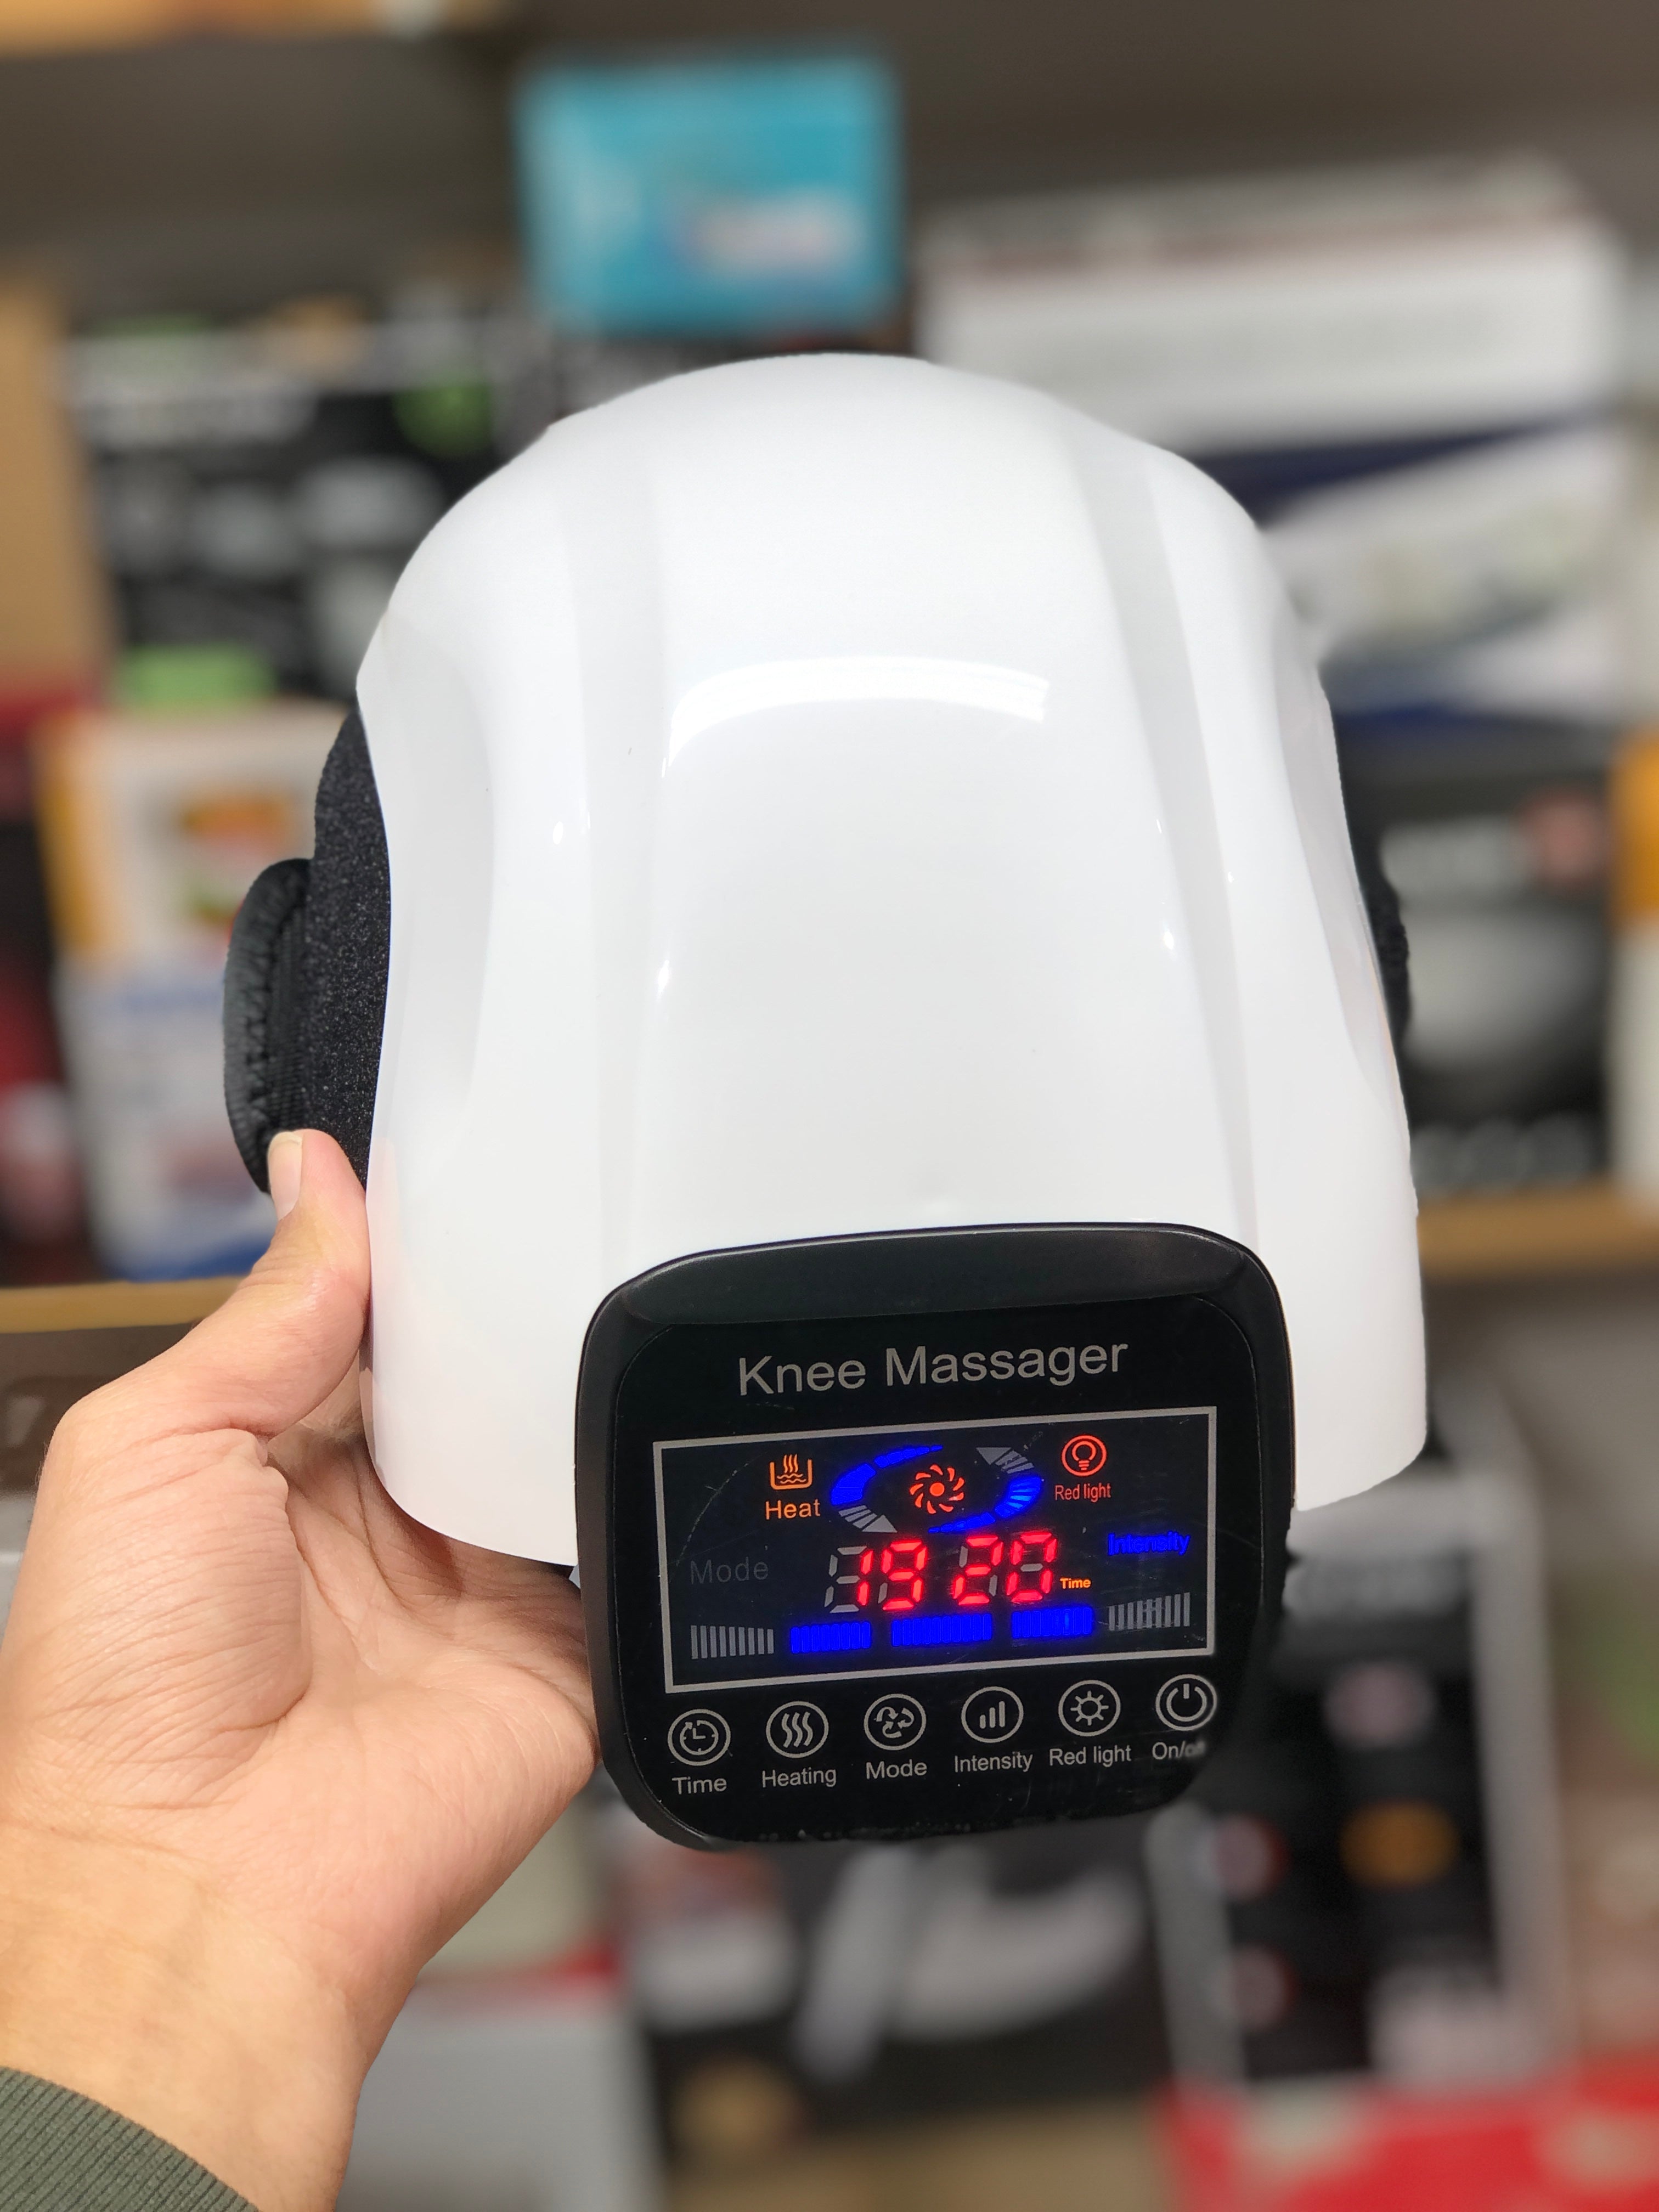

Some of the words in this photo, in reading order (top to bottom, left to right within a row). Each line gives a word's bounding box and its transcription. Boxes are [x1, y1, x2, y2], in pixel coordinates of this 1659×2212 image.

[740, 1356, 865, 1395] Knee
[887, 1344, 1127, 1386] Massager
[1056, 1485, 1080, 1499] Red
[1084, 1483, 1110, 1502] light
[766, 1499, 820, 1519] Heat
[1109, 1532, 1189, 1554] Intensity
[691, 1557, 768, 1584] Mode
[1060, 1578, 1091, 1589] Time
[955, 1752, 1032, 1772] Intensity
[1050, 1747, 1086, 1765] Red
[1094, 1745, 1131, 1767] light
[763, 1767, 836, 1787] Heating
[866, 1759, 927, 1779] Mode
[672, 1777, 726, 1794] Time
